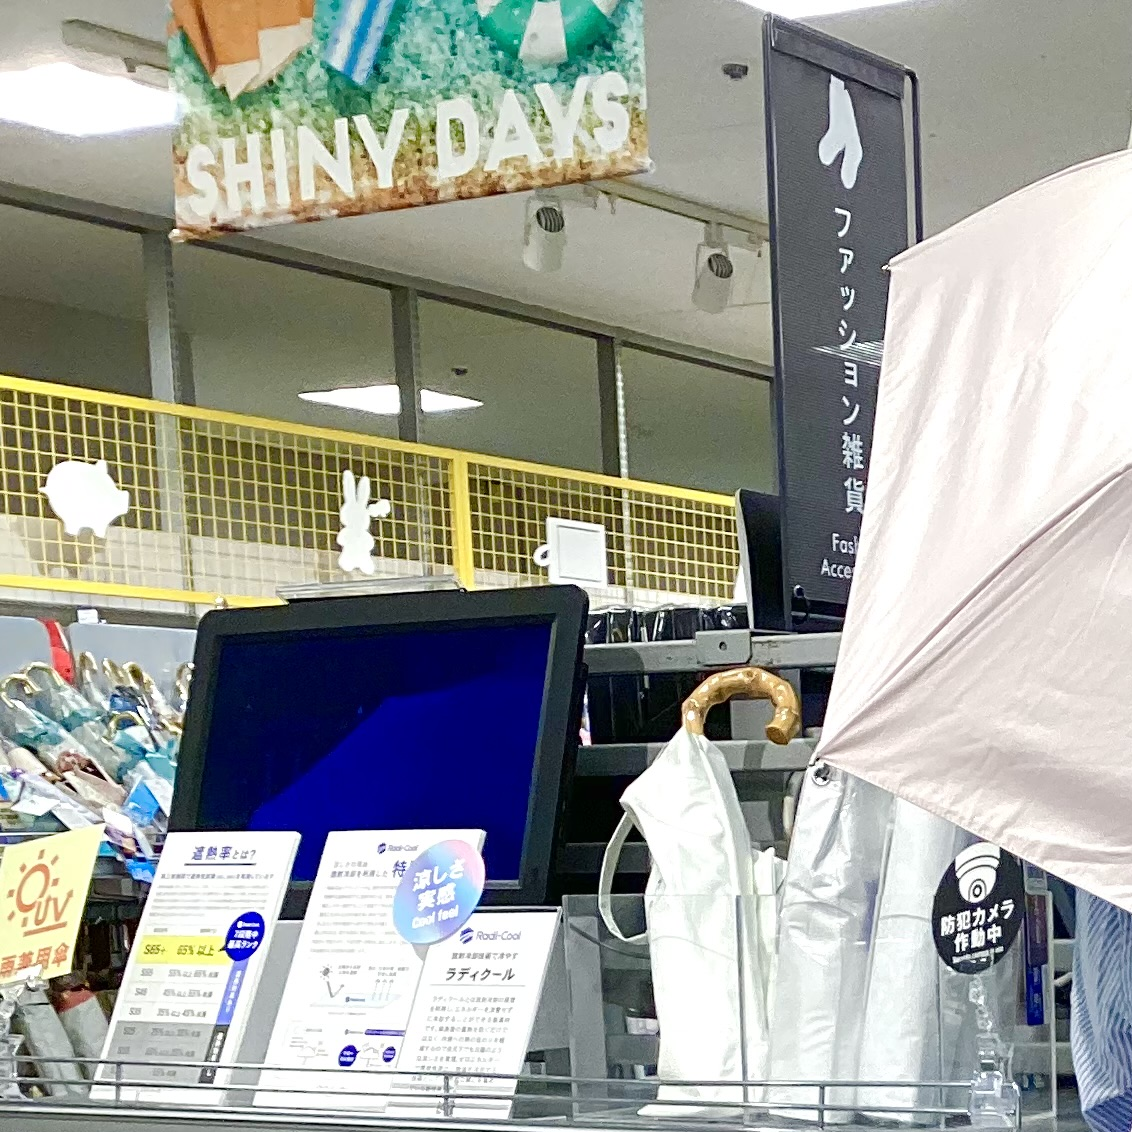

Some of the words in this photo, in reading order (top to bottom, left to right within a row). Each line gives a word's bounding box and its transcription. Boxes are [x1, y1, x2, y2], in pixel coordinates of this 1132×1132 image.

[186, 108, 409, 221] SHINY
[436, 71, 631, 180] DAYS
[833, 206, 864, 514] ファッション雑貨
[820, 558, 856, 579] Acce
[412, 858, 466, 892] 涼しさ
[34, 888, 74, 926] UV
[416, 882, 457, 912] 実感
[411, 912, 436, 929] Cool
[437, 904, 460, 923] feel
[940, 898, 1015, 937] 防犯カメラ
[475, 930, 522, 941] Radi-Cool
[954, 923, 1003, 954] 作動中
[445, 967, 516, 982] ラディクール
